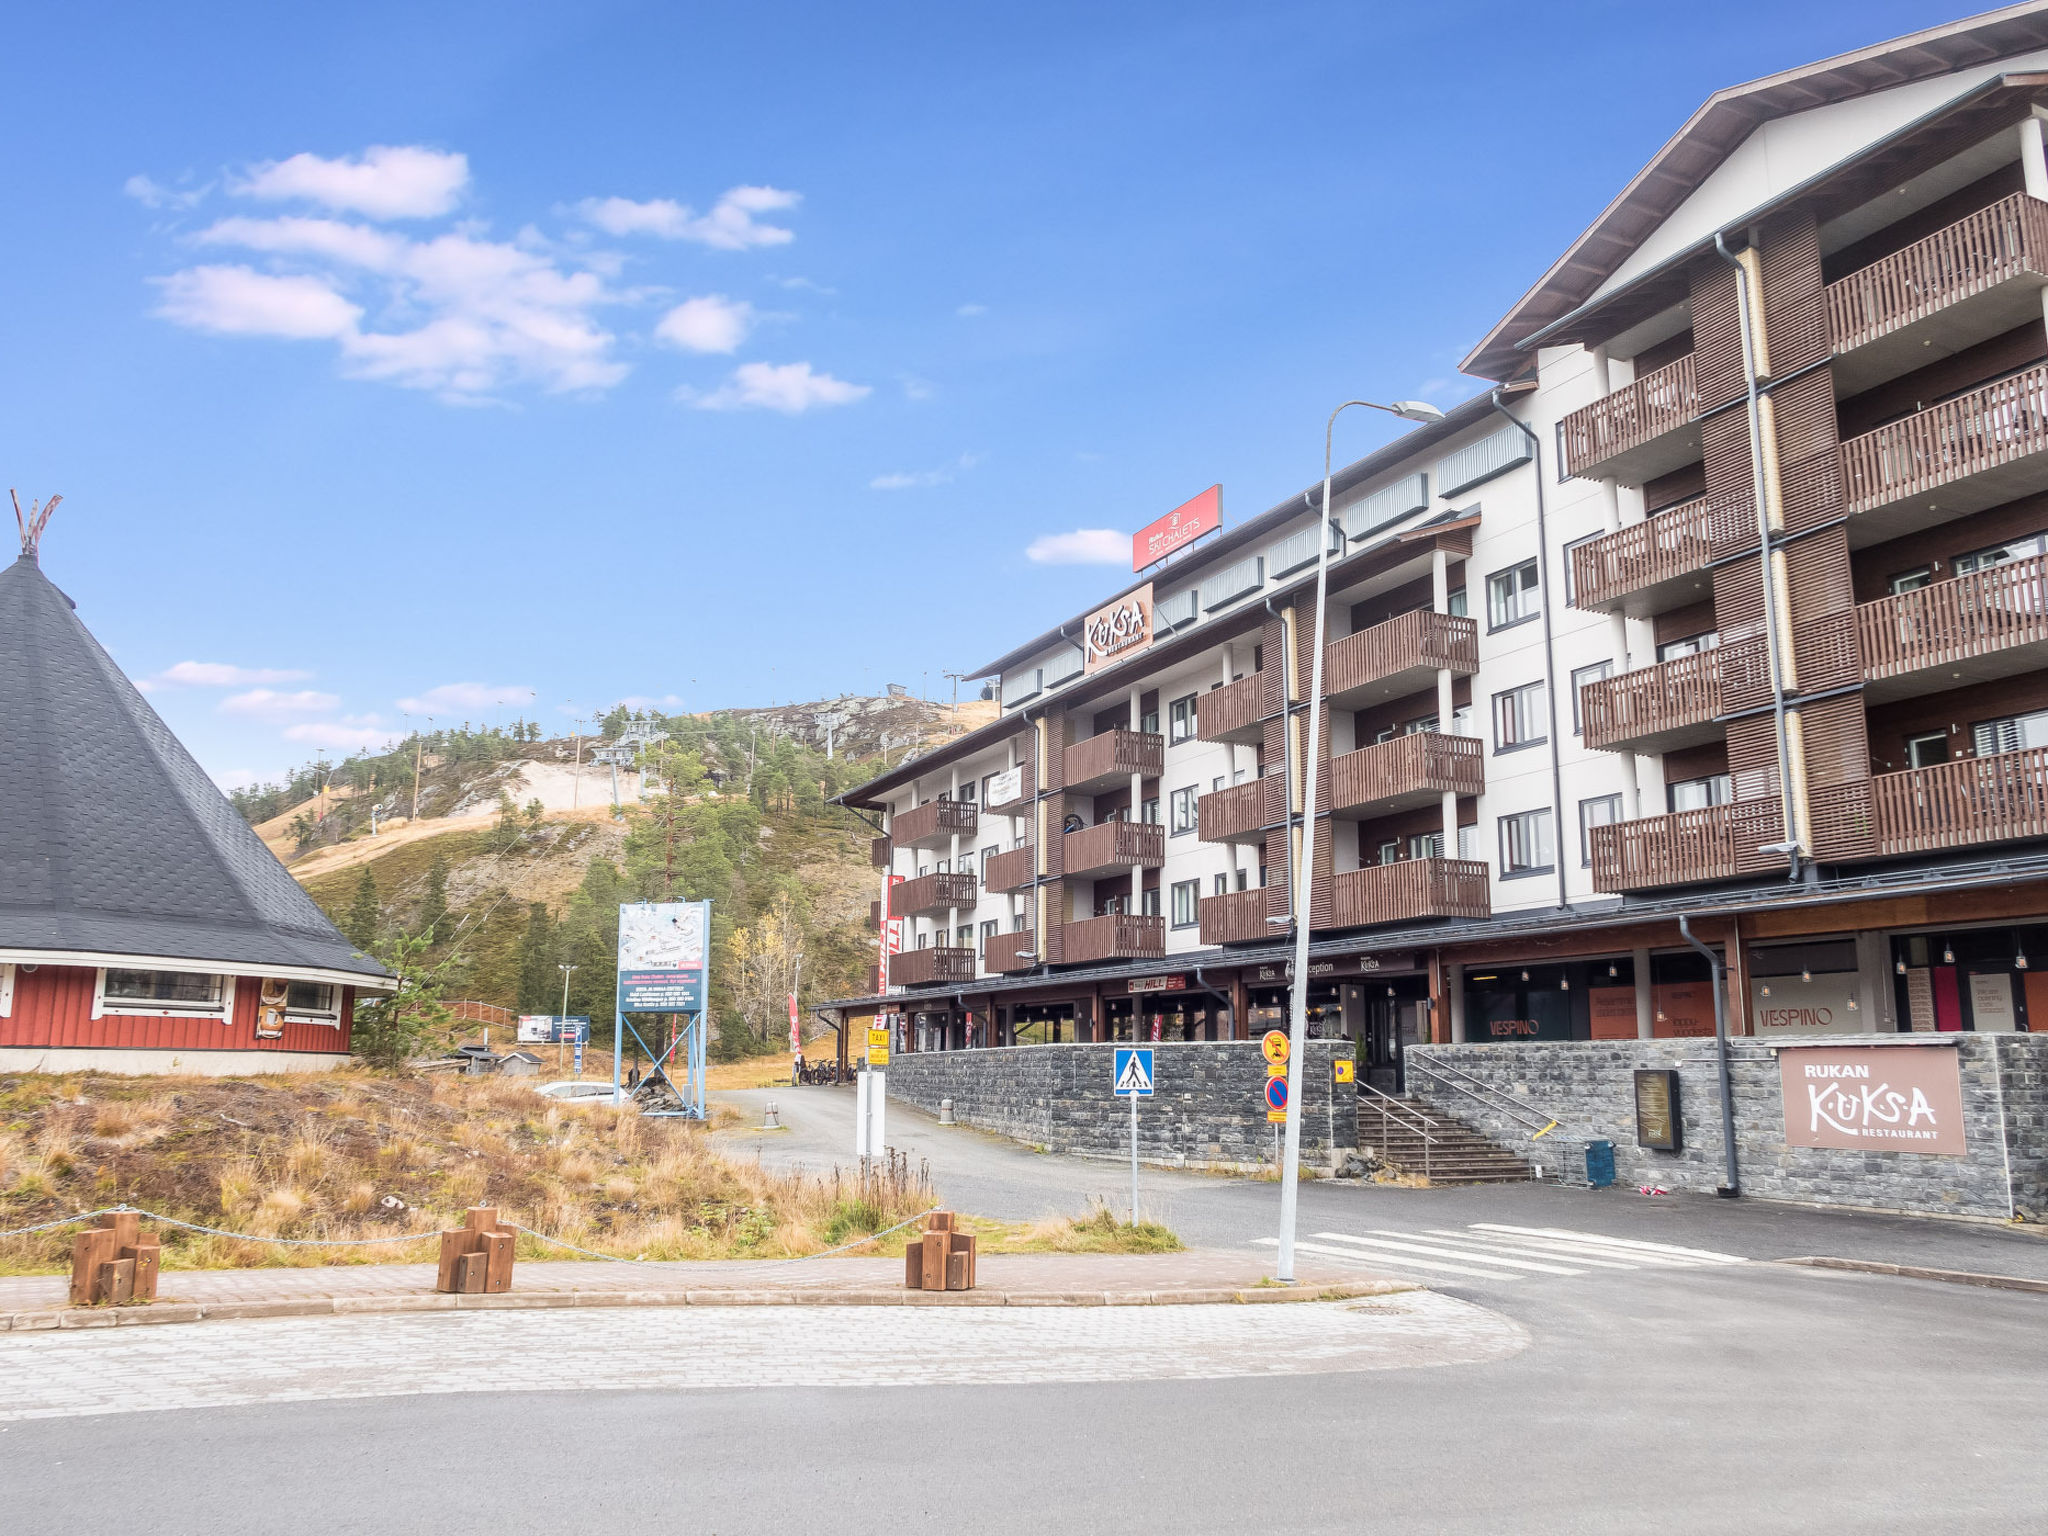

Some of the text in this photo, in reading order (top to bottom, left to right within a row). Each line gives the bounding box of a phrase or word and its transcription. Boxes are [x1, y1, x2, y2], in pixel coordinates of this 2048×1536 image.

[1149, 539, 1161, 555] SKI
[1162, 517, 1201, 547] CHALETS
[1086, 600, 1144, 663] KUKSA
[1307, 961, 1334, 975] ception
[1760, 1007, 1833, 1027] VESPINO
[1489, 1019, 1540, 1036] VESPINO
[871, 1032, 886, 1041] TAXI
[1804, 1064, 1869, 1078] RUKAN
[1808, 1082, 1937, 1136] KUKSA
[1862, 1128, 1938, 1139] RESTAURANT
